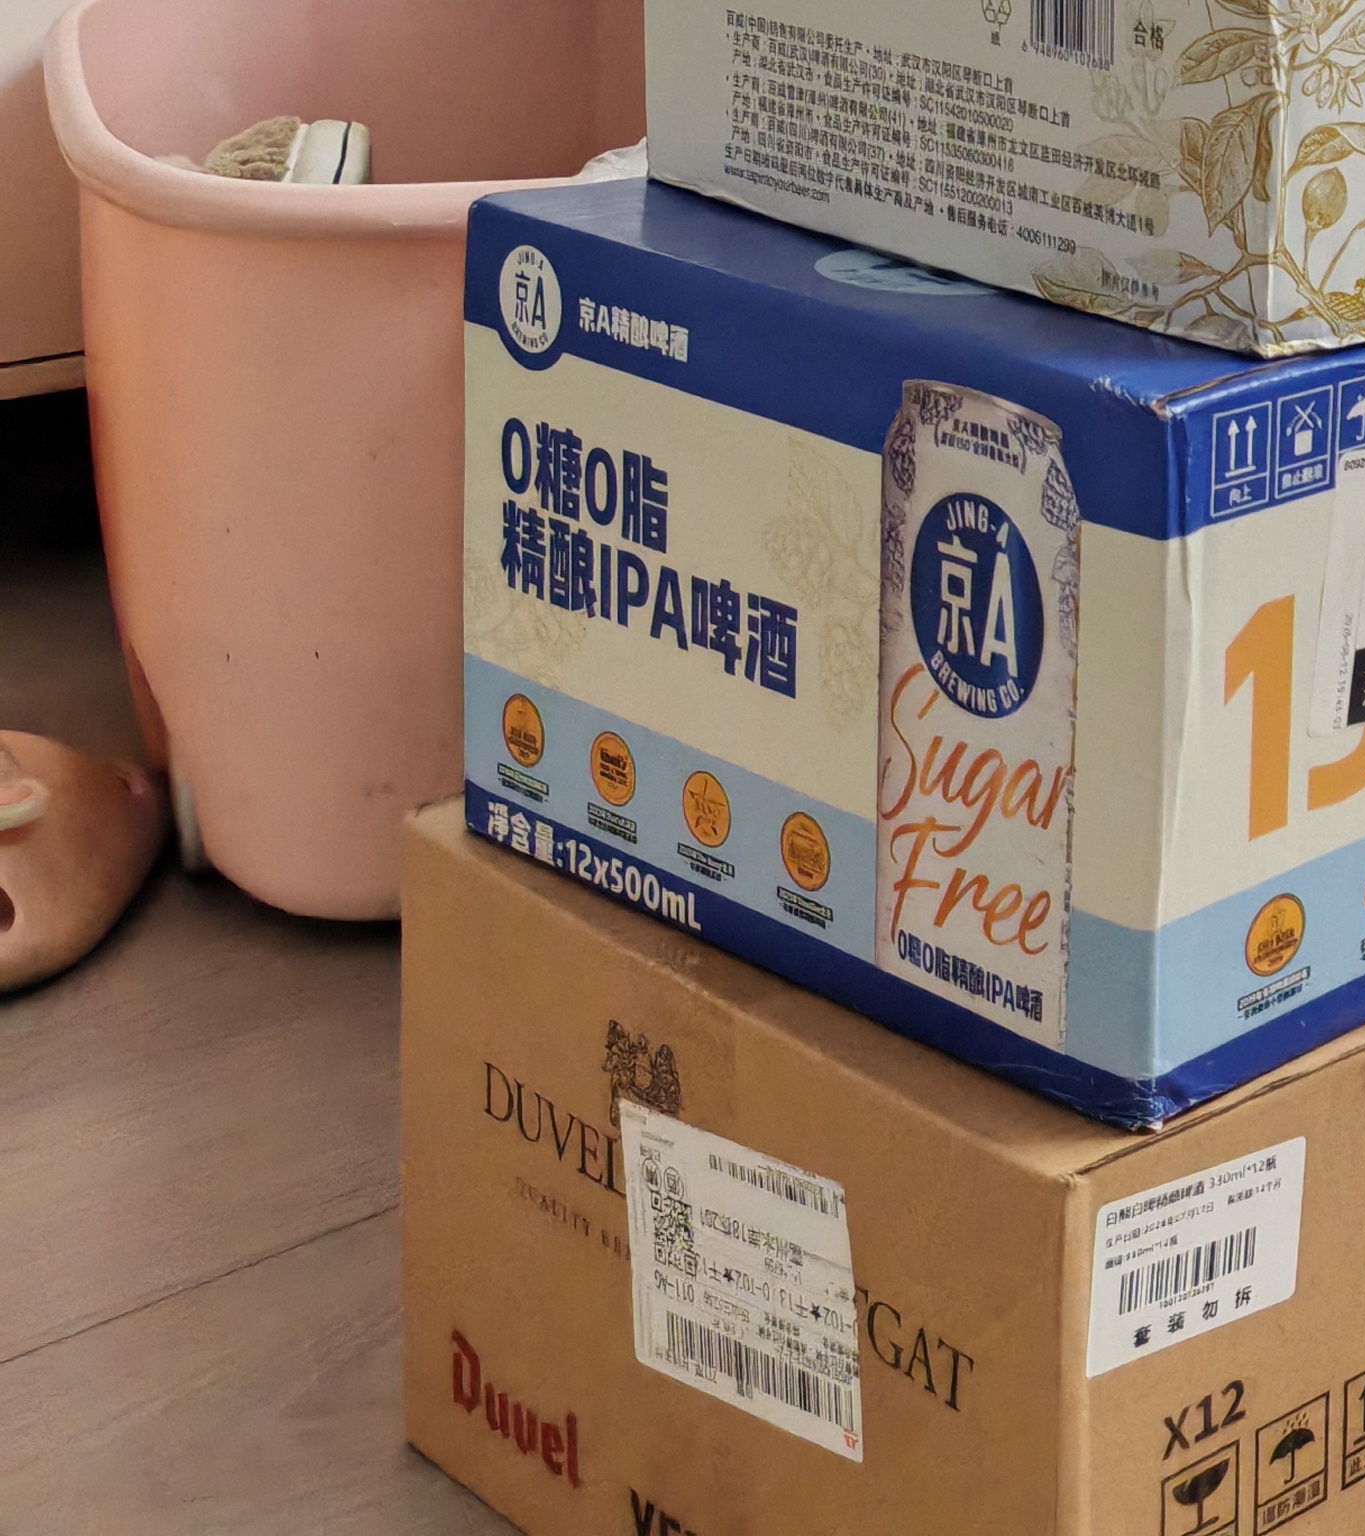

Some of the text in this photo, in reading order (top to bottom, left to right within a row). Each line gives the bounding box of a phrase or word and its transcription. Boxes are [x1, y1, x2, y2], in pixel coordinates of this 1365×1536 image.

[1134, 20, 1165, 51] 合格
[514, 271, 547, 330] 京A
[578, 296, 690, 363] 京A精酿啤酒
[500, 415, 669, 554] 0糖0脂
[946, 500, 1010, 549] JING-A
[1229, 483, 1252, 506] 向上
[500, 500, 799, 699] 精酿IPA啤酒
[936, 534, 1019, 678] 京A
[930, 650, 997, 714] BREWING
[879, 665, 1074, 832] Sugar
[890, 815, 1052, 956] Free
[484, 1061, 627, 1197] DUVEL
[855, 1285, 975, 1413] GAT
[1133, 1285, 1254, 1349] 套装勿拆
[452, 1328, 581, 1490] Duvel
[1162, 1379, 1247, 1461] X12
